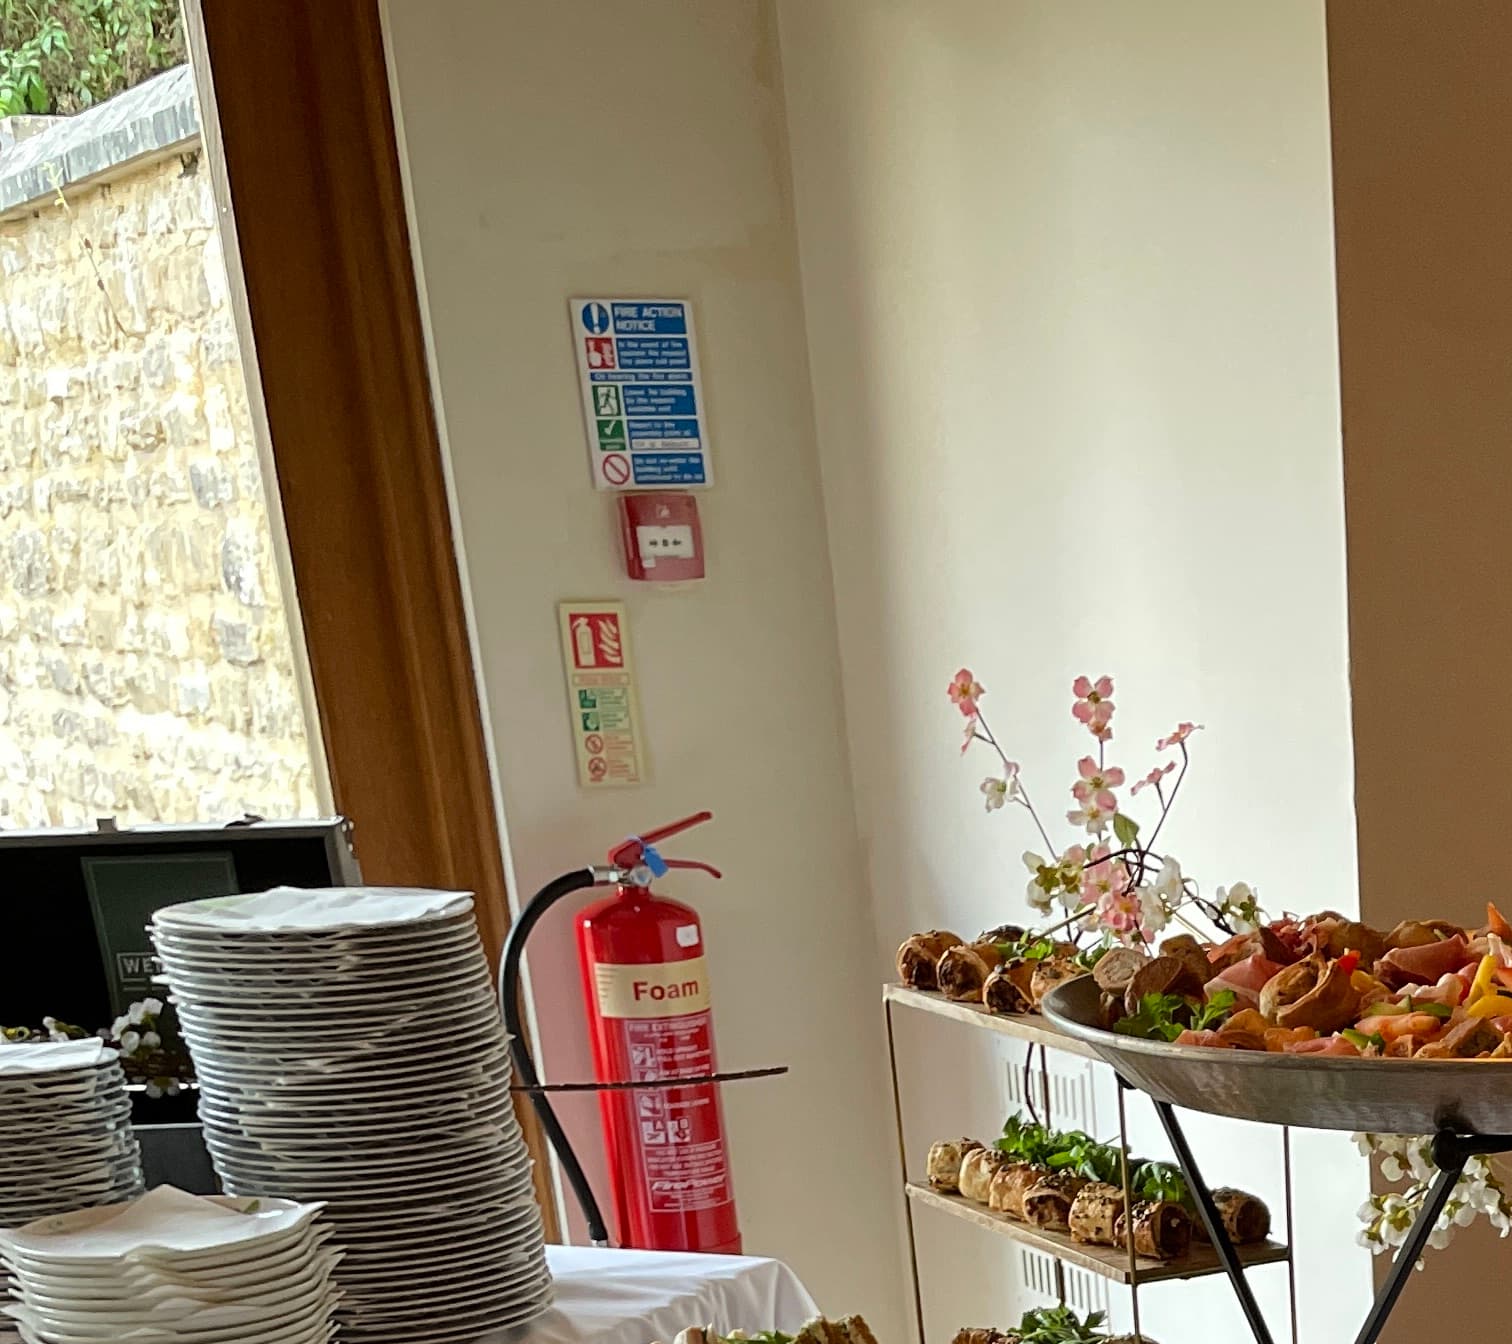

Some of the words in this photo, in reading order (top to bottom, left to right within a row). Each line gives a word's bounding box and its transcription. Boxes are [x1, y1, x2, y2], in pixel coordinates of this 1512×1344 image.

[614, 306, 637, 318] FIRE
[642, 306, 682, 318] ACTION
[616, 320, 656, 331] NOTICE
[633, 980, 699, 1001] Foam
